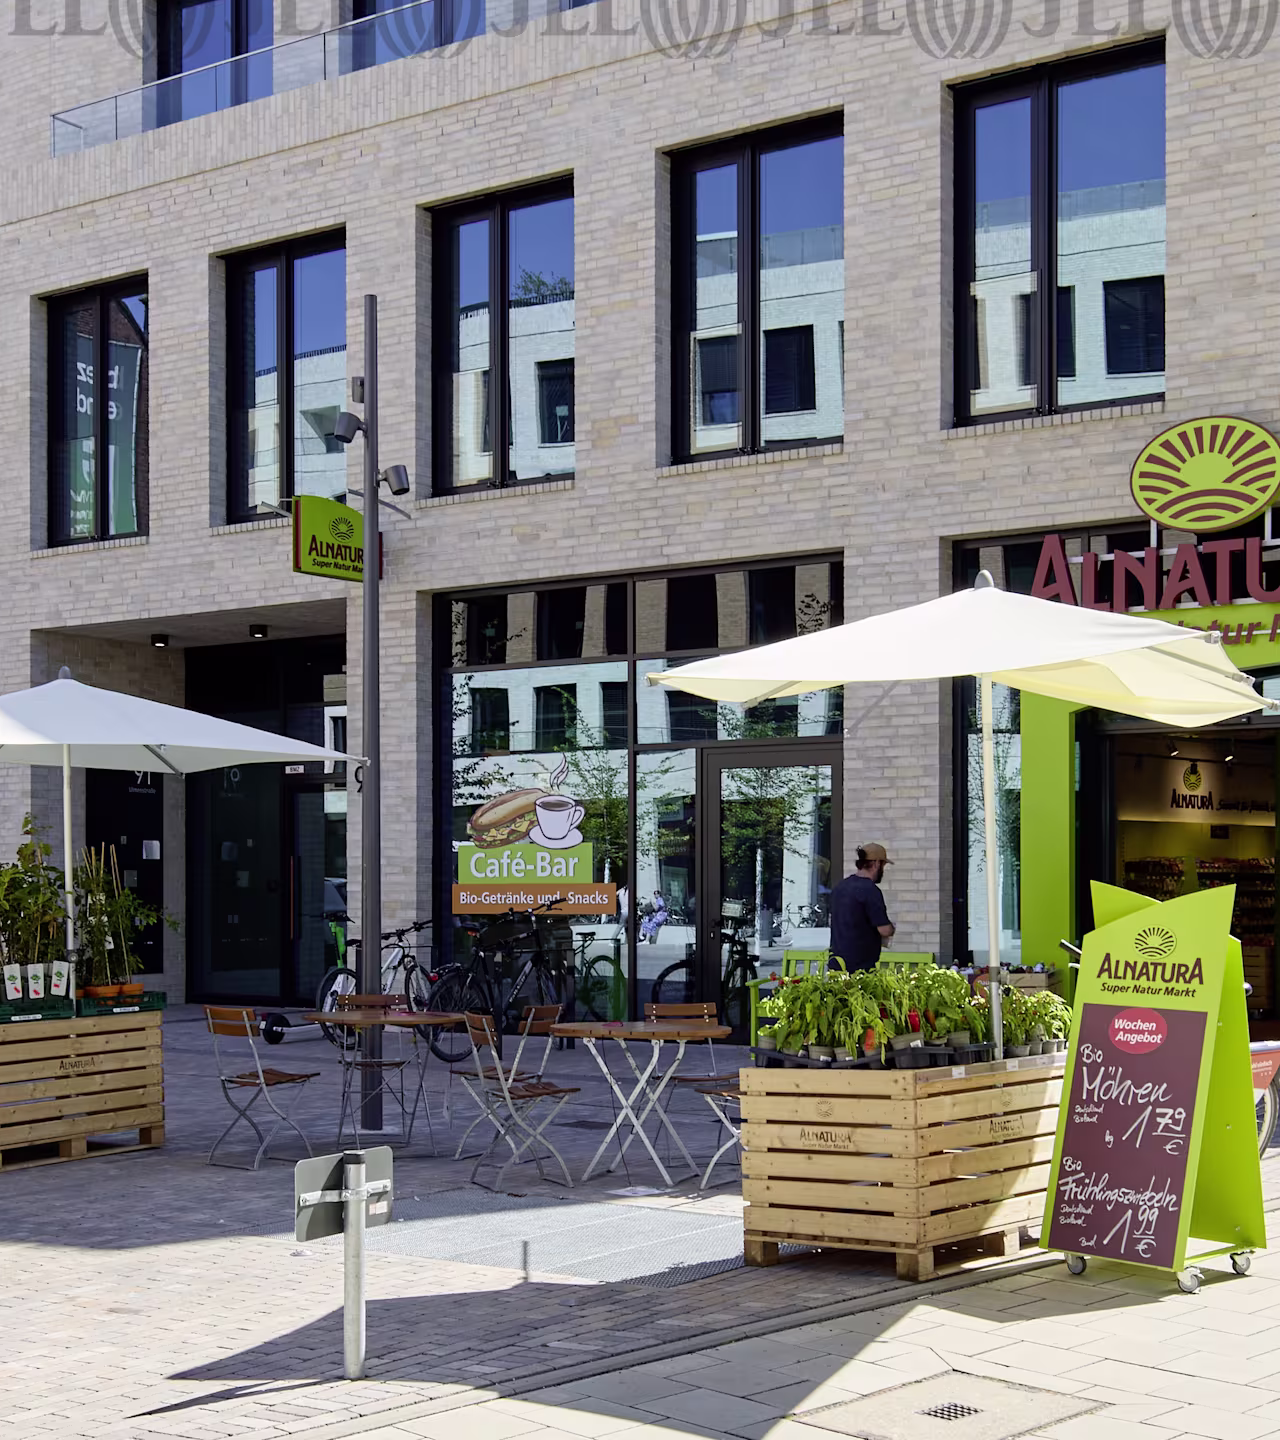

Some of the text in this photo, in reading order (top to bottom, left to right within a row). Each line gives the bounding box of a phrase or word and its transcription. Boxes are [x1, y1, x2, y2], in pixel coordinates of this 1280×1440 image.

[308, 534, 363, 565] ALNATUR
[312, 558, 332, 569] Super
[333, 562, 352, 571] Natur
[1170, 788, 1214, 810] ALNATURA
[470, 850, 579, 878] Café-Bar
[459, 891, 608, 904] Bio-Getränke und Snacks
[1096, 952, 1204, 985] ALNATURA
[1100, 982, 1196, 998] Super Natur Markt
[1114, 1019, 1157, 1031] Wochen
[1115, 1031, 1163, 1044] Angebot
[1080, 1043, 1103, 1063] Bio
[1082, 1066, 1173, 1106] Möhren
[800, 1127, 852, 1143] ALNATURA
[1063, 1156, 1082, 1171] Bio
